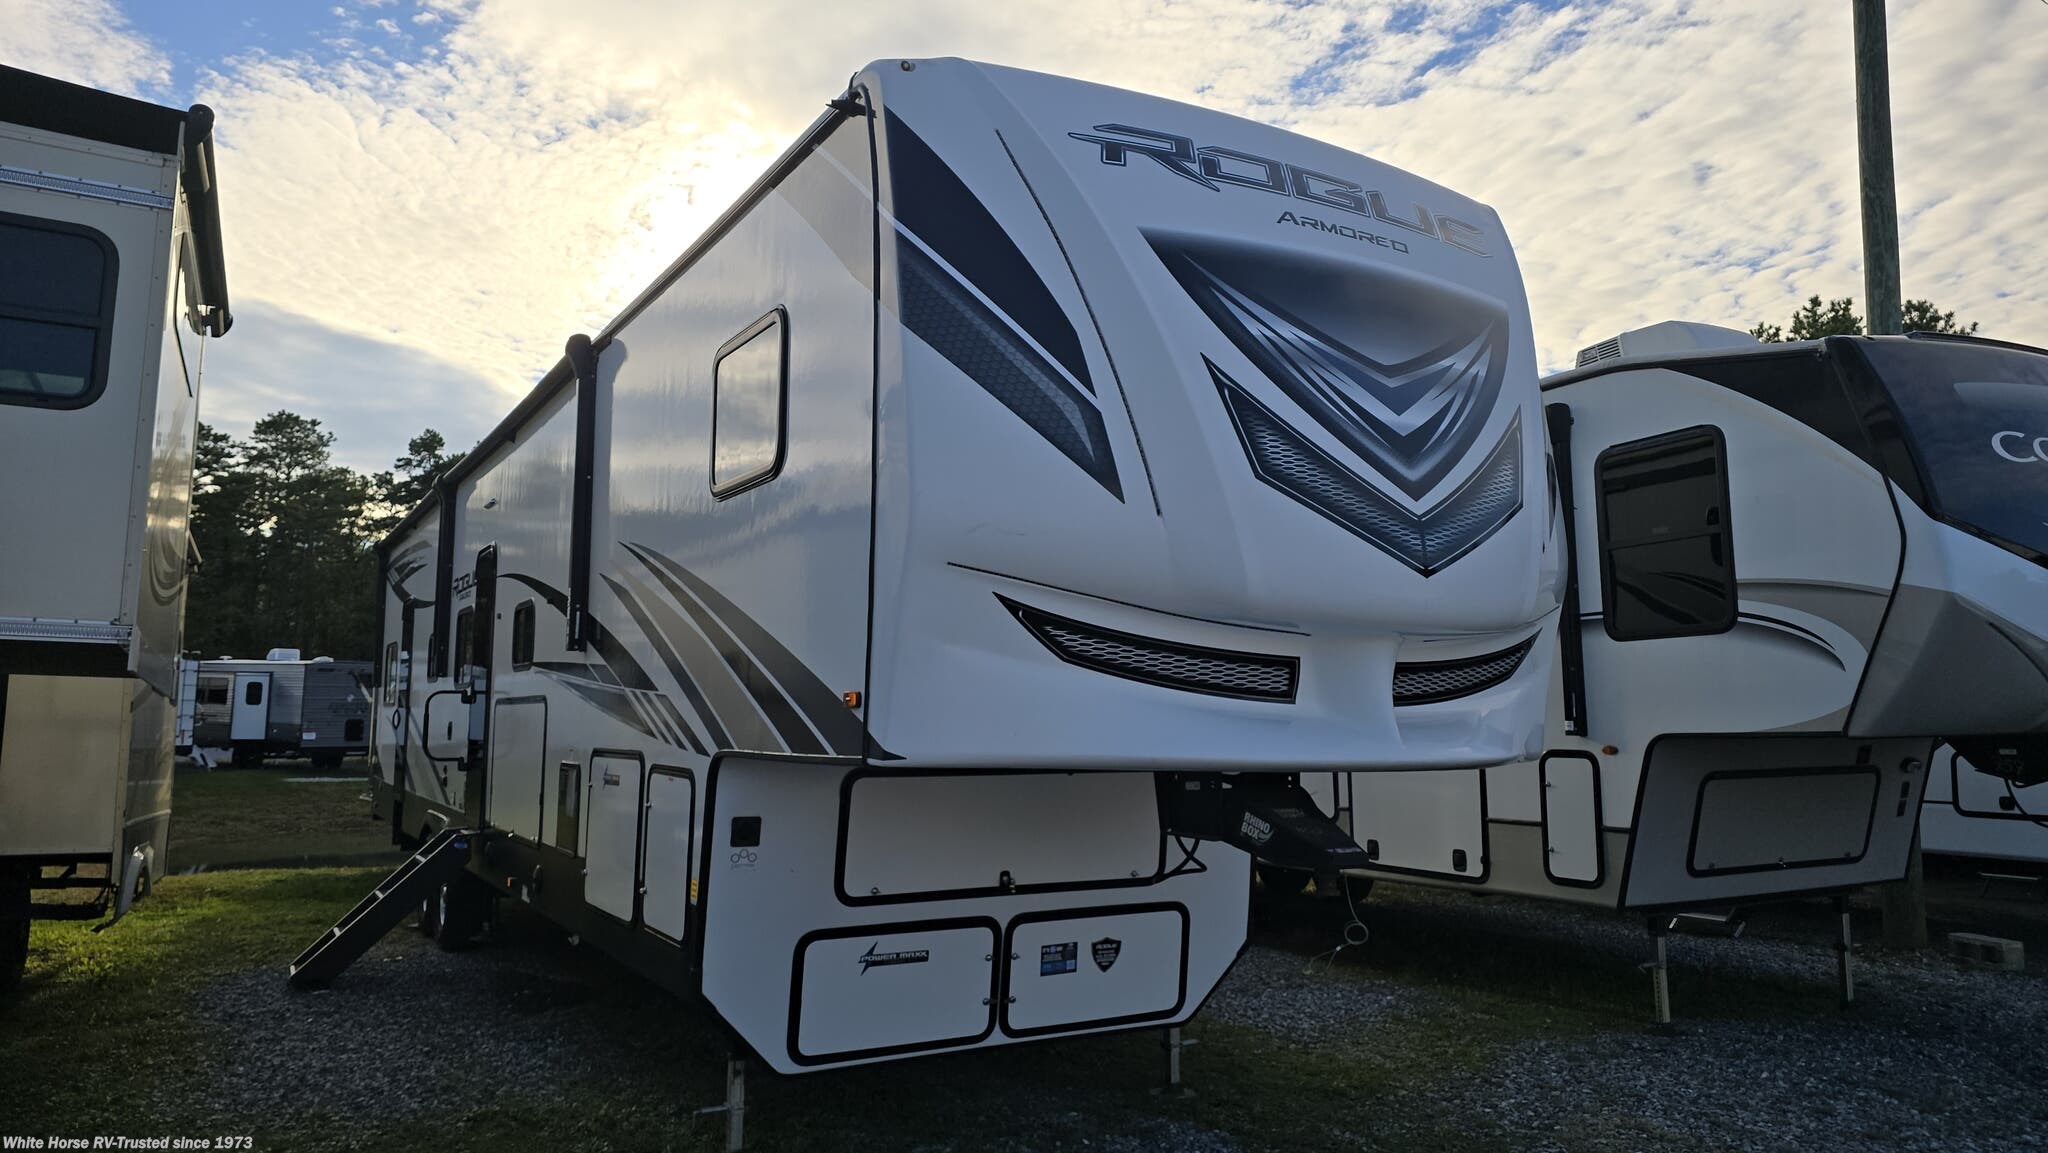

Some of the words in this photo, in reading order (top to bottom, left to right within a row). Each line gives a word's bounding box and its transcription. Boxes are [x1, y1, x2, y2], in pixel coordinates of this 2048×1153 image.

[1067, 122, 1493, 259] ROGUE
[1276, 211, 1409, 254] ARMORED
[1241, 821, 1260, 840] BOX
[1243, 811, 1271, 833] RHINO
[861, 952, 897, 962] POWER
